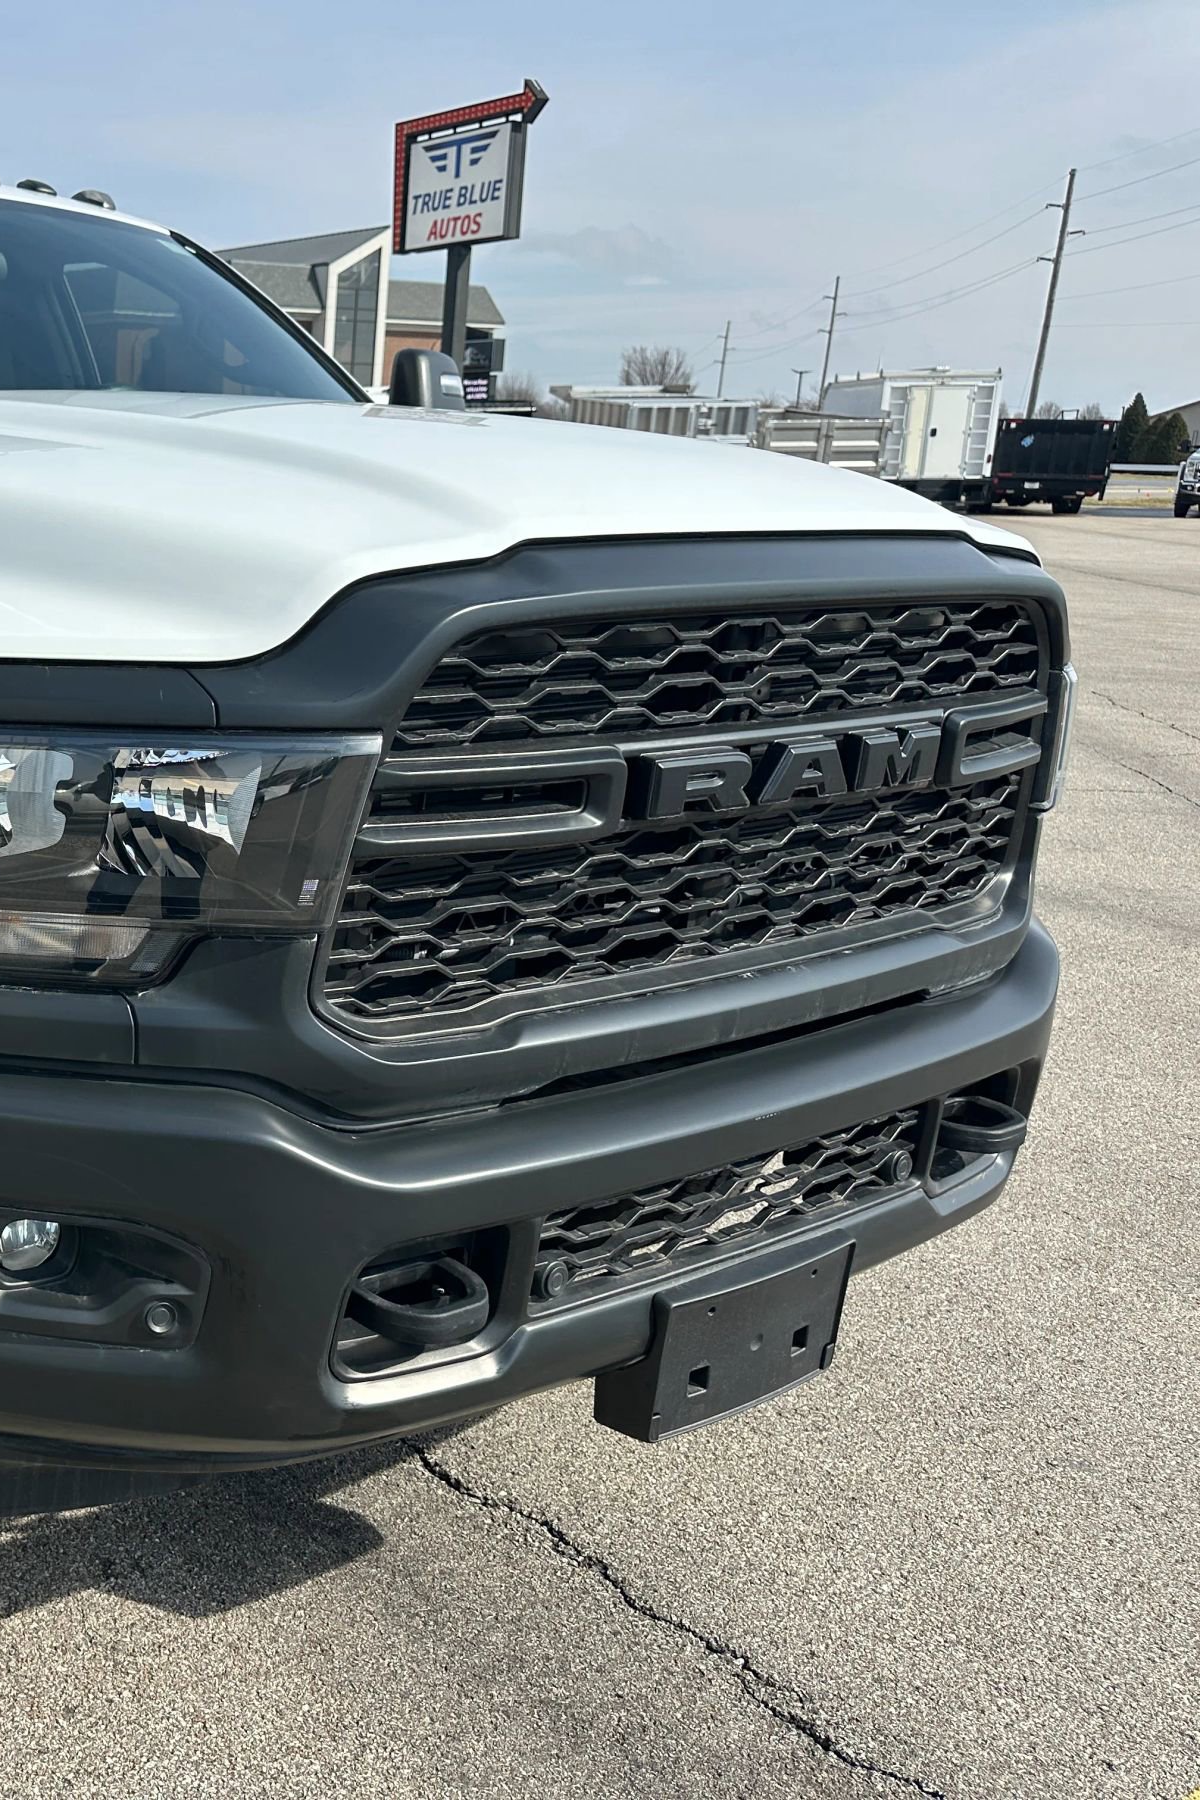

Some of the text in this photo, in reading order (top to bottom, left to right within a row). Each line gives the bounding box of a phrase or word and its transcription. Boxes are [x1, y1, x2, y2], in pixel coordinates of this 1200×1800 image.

[412, 178, 503, 215] TRUE BLUE
[426, 212, 483, 242] AUTOS
[641, 722, 942, 820] RAM
